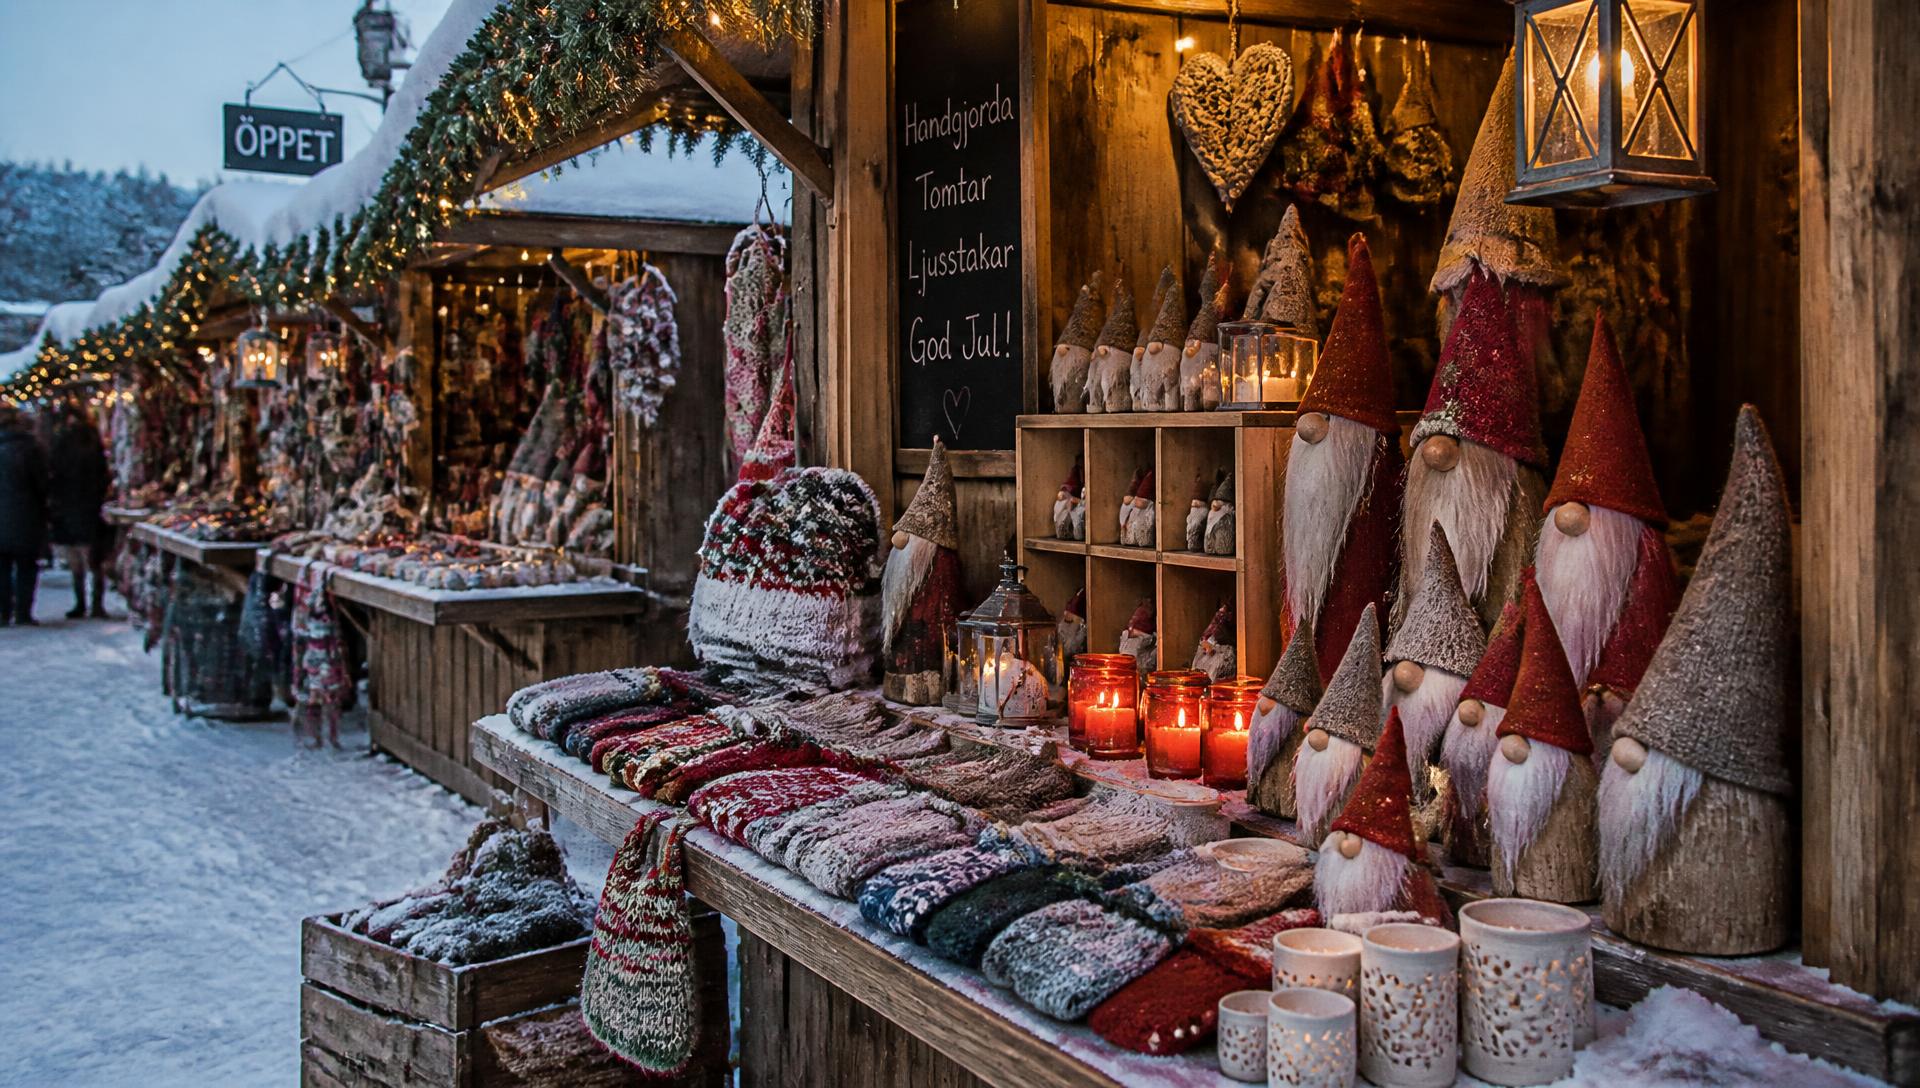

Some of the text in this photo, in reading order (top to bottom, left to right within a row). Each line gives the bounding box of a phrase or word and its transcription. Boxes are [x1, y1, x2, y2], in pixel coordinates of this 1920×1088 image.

[234, 114, 336, 163] ÖPPET
[905, 83, 1014, 150] Handgjorda
[915, 167, 992, 211] Tomtar
[908, 232, 1014, 297] Ljusstakar
[909, 310, 1011, 366] God Jul!
